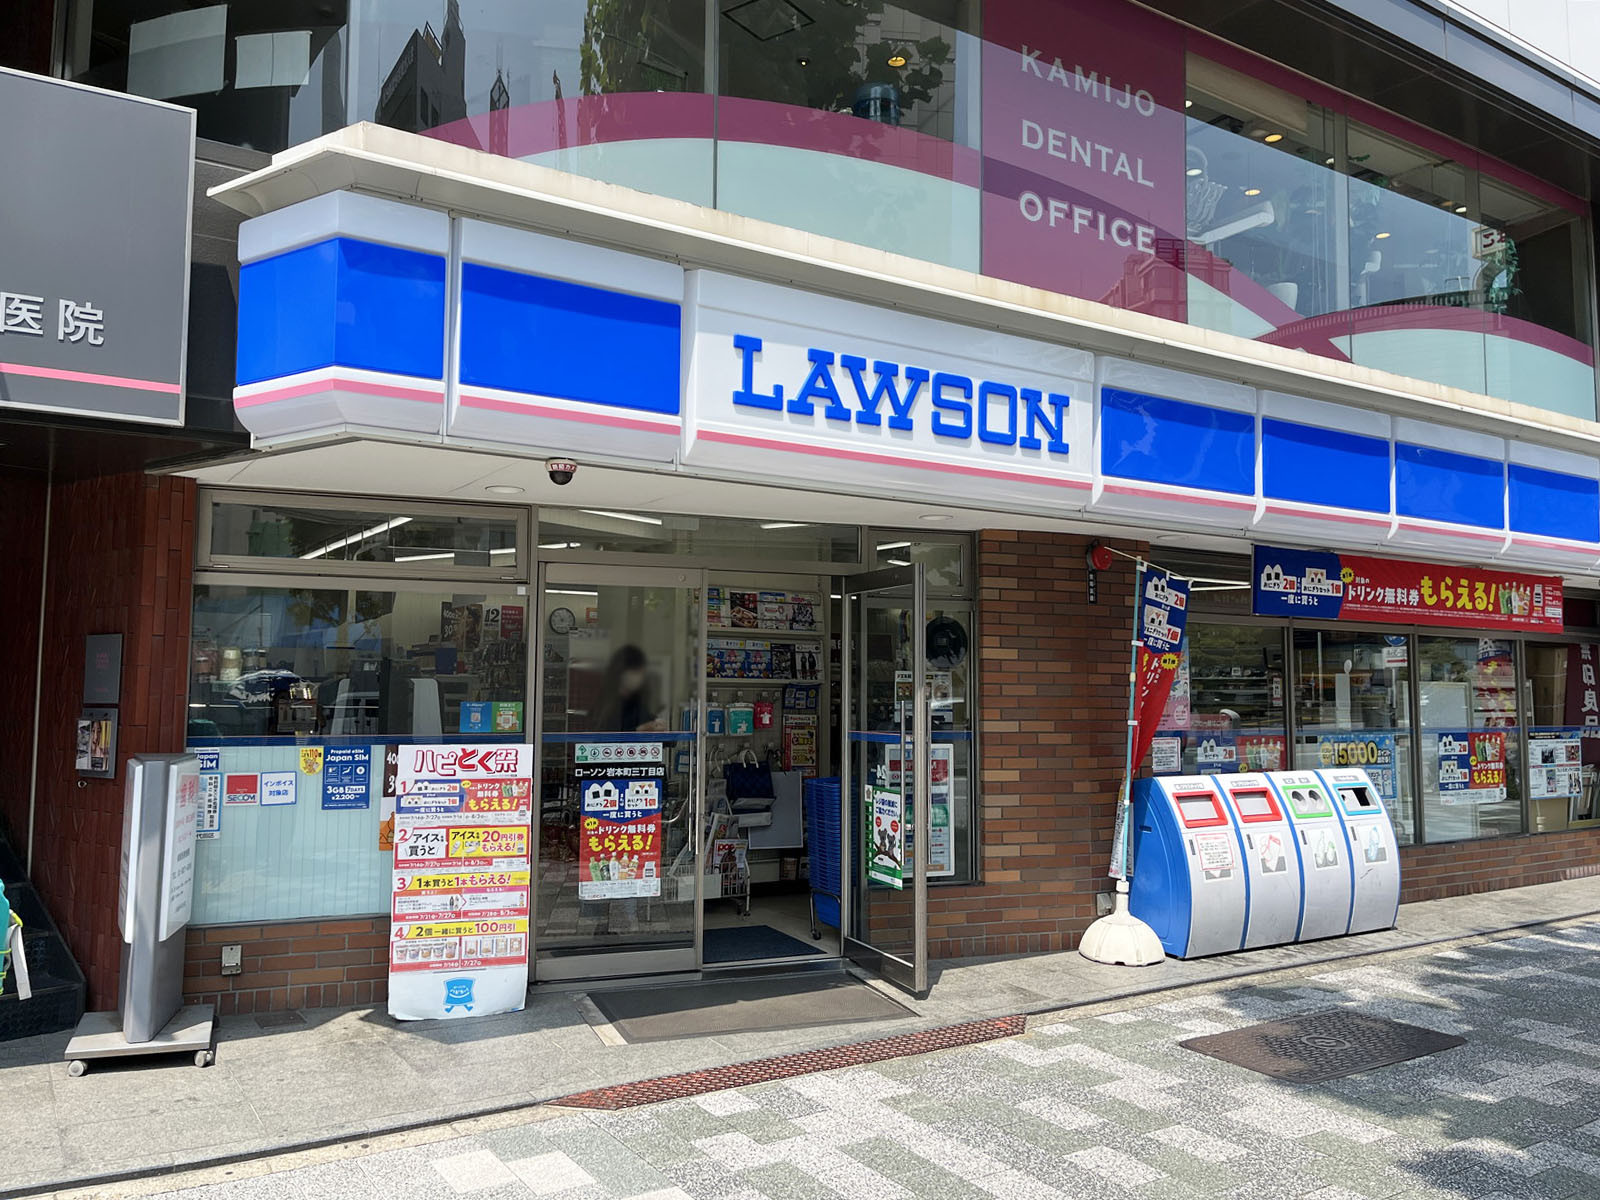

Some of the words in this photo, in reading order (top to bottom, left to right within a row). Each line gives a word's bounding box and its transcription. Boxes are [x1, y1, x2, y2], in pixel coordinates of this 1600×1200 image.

[1021, 44, 1155, 117] KAMIJO
[1021, 119, 1154, 188] DENTAL
[1020, 192, 1155, 255] OFFICE
[0, 291, 104, 345] 医院
[733, 334, 1069, 455] LAWSON
[1420, 575, 1496, 612] もらえる!
[326, 754, 353, 763] Japan
[414, 747, 518, 777] ハピとく祭
[575, 766, 664, 778] ローソン岩本町三丁目店
[264, 780, 294, 788] インボイス
[327, 785, 345, 794] 3GB
[227, 793, 256, 804] SECOM
[268, 789, 289, 798] 対象店
[468, 798, 518, 811] もらえる!
[603, 811, 642, 819] 一度に買うと
[588, 834, 654, 852] もらえる!
[409, 845, 436, 857] 買うと
